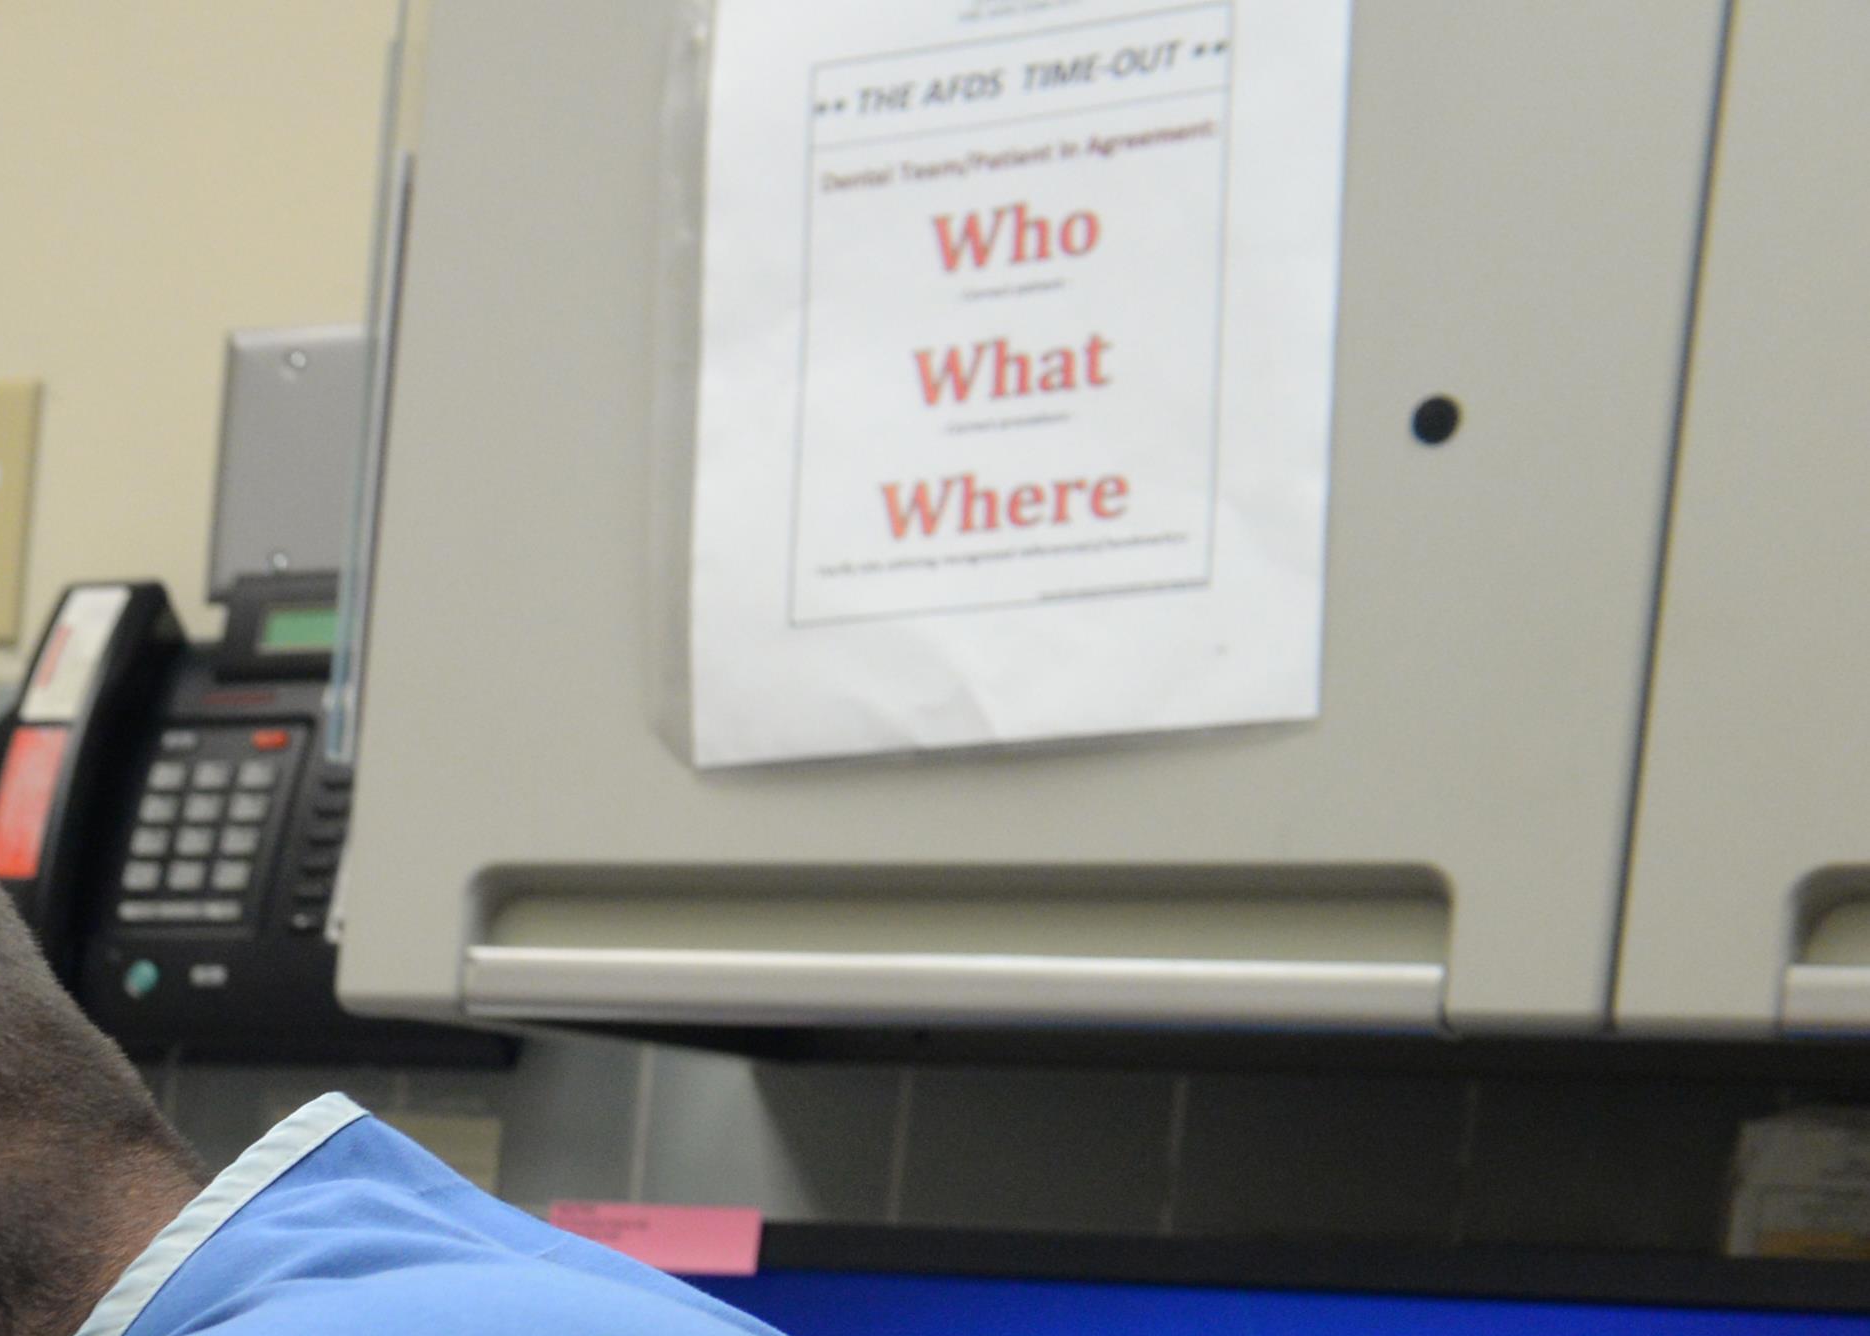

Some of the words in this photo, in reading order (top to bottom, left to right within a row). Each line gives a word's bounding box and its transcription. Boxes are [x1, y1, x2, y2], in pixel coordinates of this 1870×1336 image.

[856, 80, 914, 114] THE
[921, 66, 1004, 106] AFDS
[1022, 38, 1181, 94] TIME-OUT
[931, 201, 1101, 274] Who
[912, 333, 1113, 407] What
[879, 472, 1130, 541] Where
